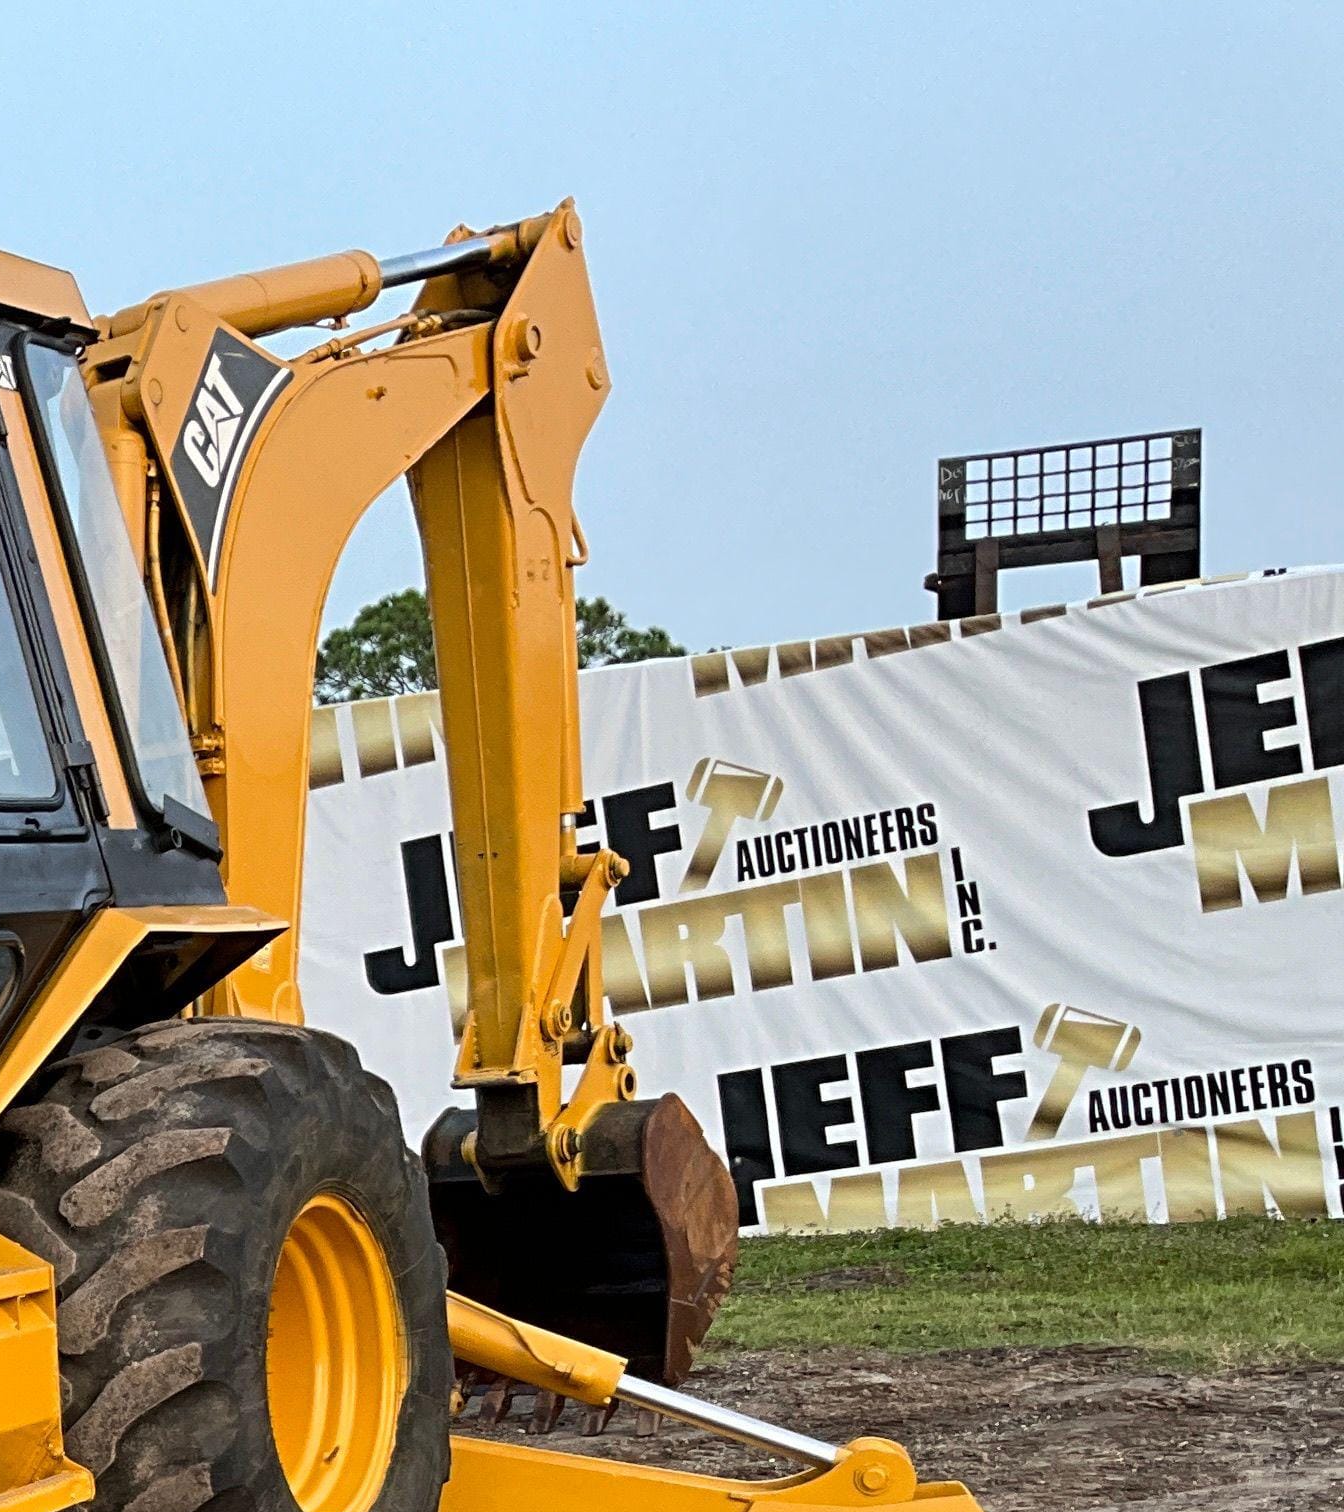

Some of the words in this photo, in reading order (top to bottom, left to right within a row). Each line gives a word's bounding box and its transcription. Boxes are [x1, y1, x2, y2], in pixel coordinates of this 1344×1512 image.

[183, 352, 244, 488] CAT
[735, 803, 939, 882] AUCTIONEERS
[717, 1025, 1028, 1228] JEFF
[1087, 1058, 1315, 1133] AUCTIONEERS
